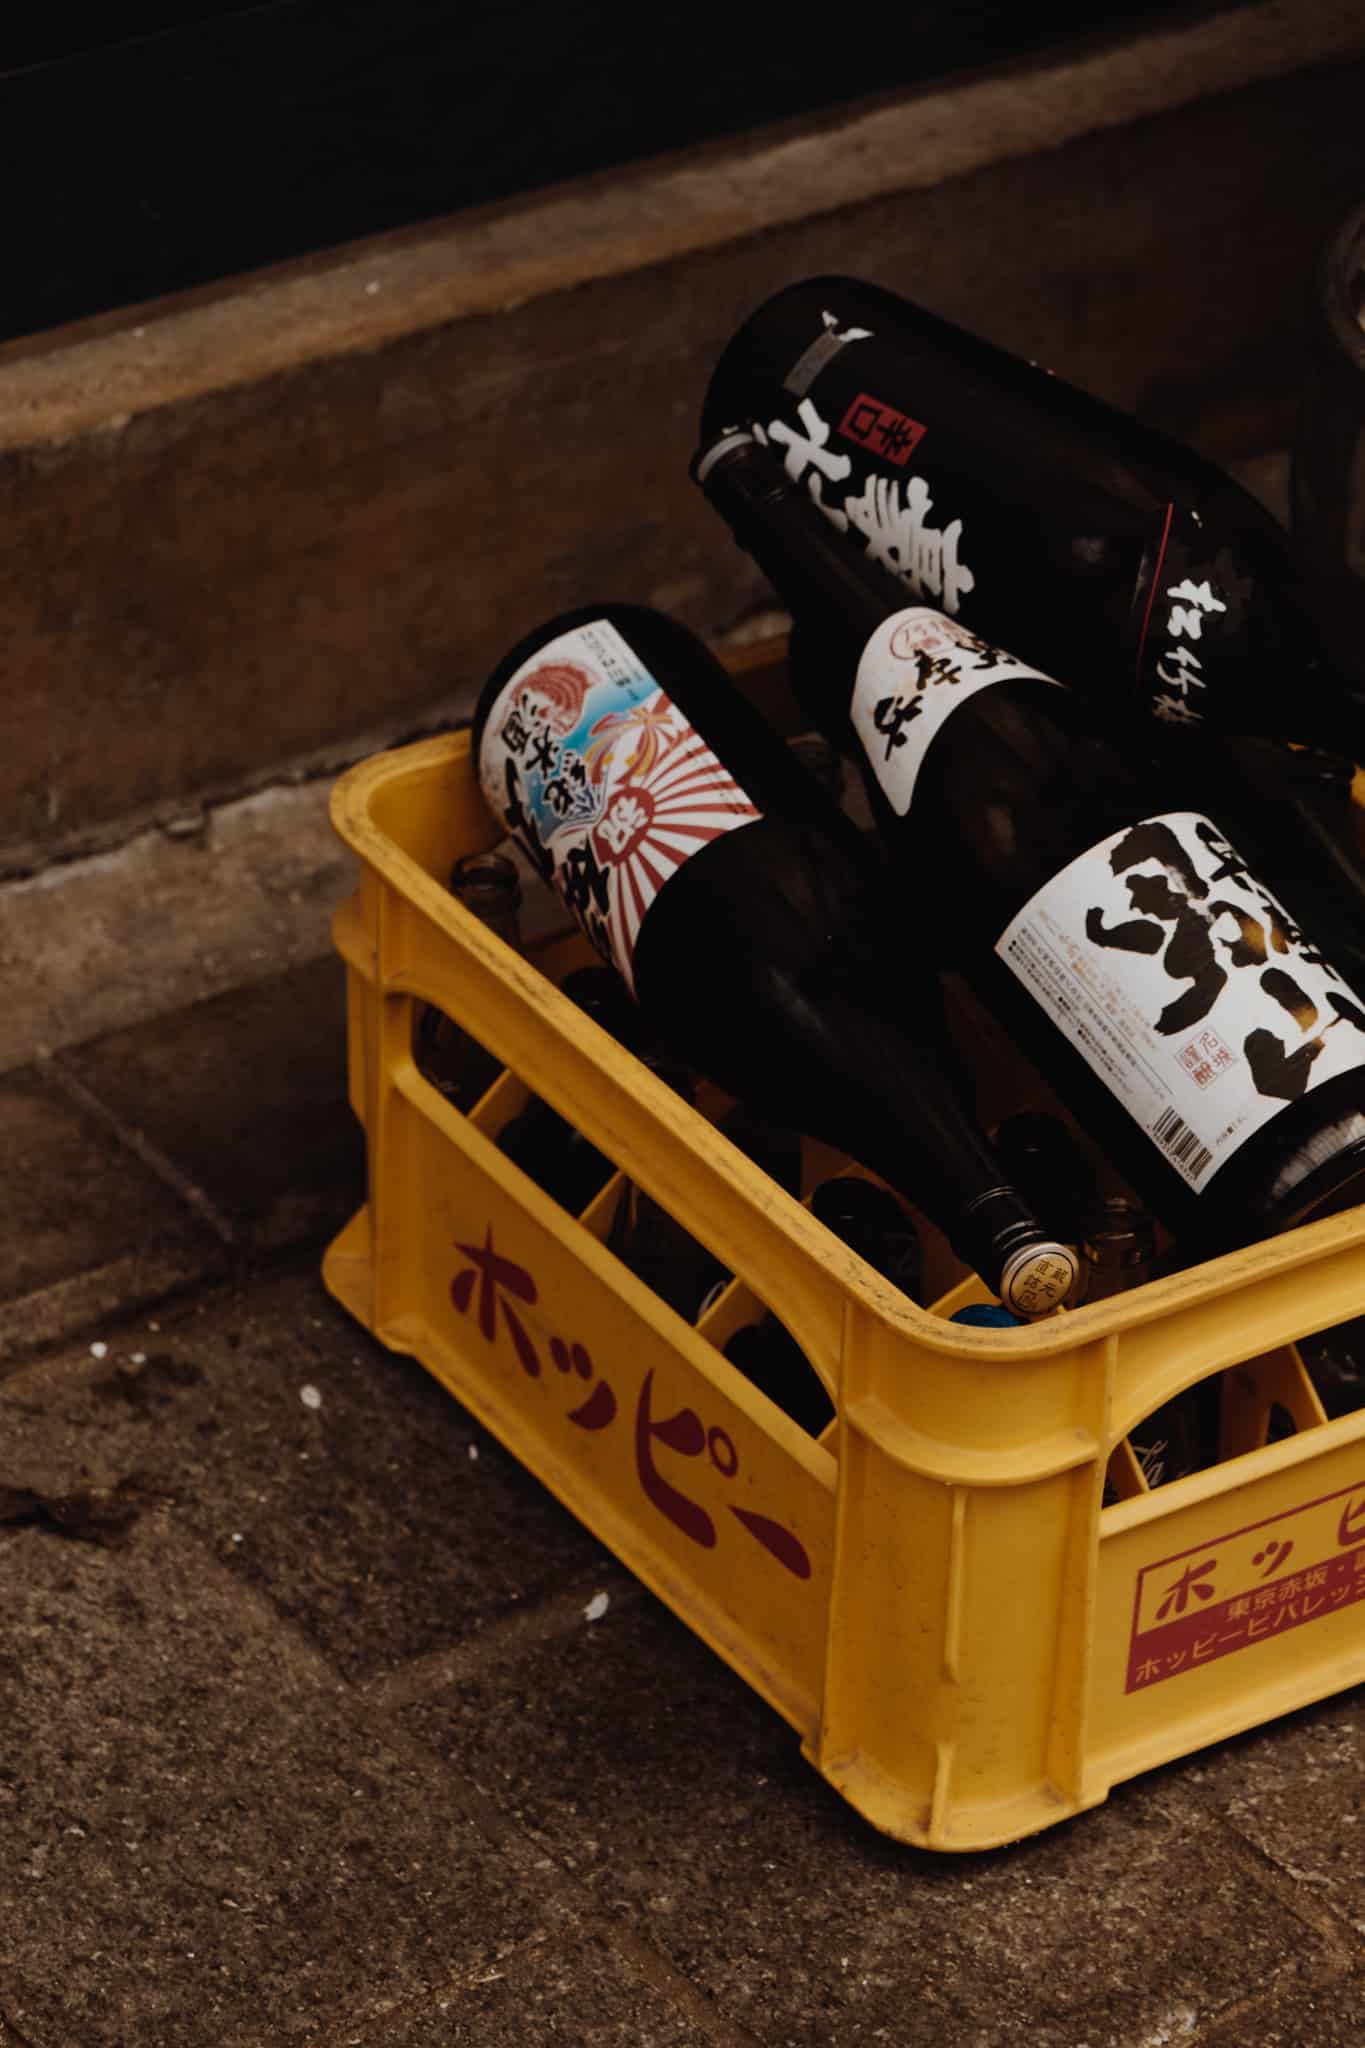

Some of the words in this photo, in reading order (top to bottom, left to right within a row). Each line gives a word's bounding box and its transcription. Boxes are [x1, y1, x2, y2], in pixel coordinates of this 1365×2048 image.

[846, 401, 917, 459] 辛口
[501, 694, 586, 816] 純米酒
[597, 793, 648, 854] 祝
[450, 1220, 811, 1579] ホッピー
